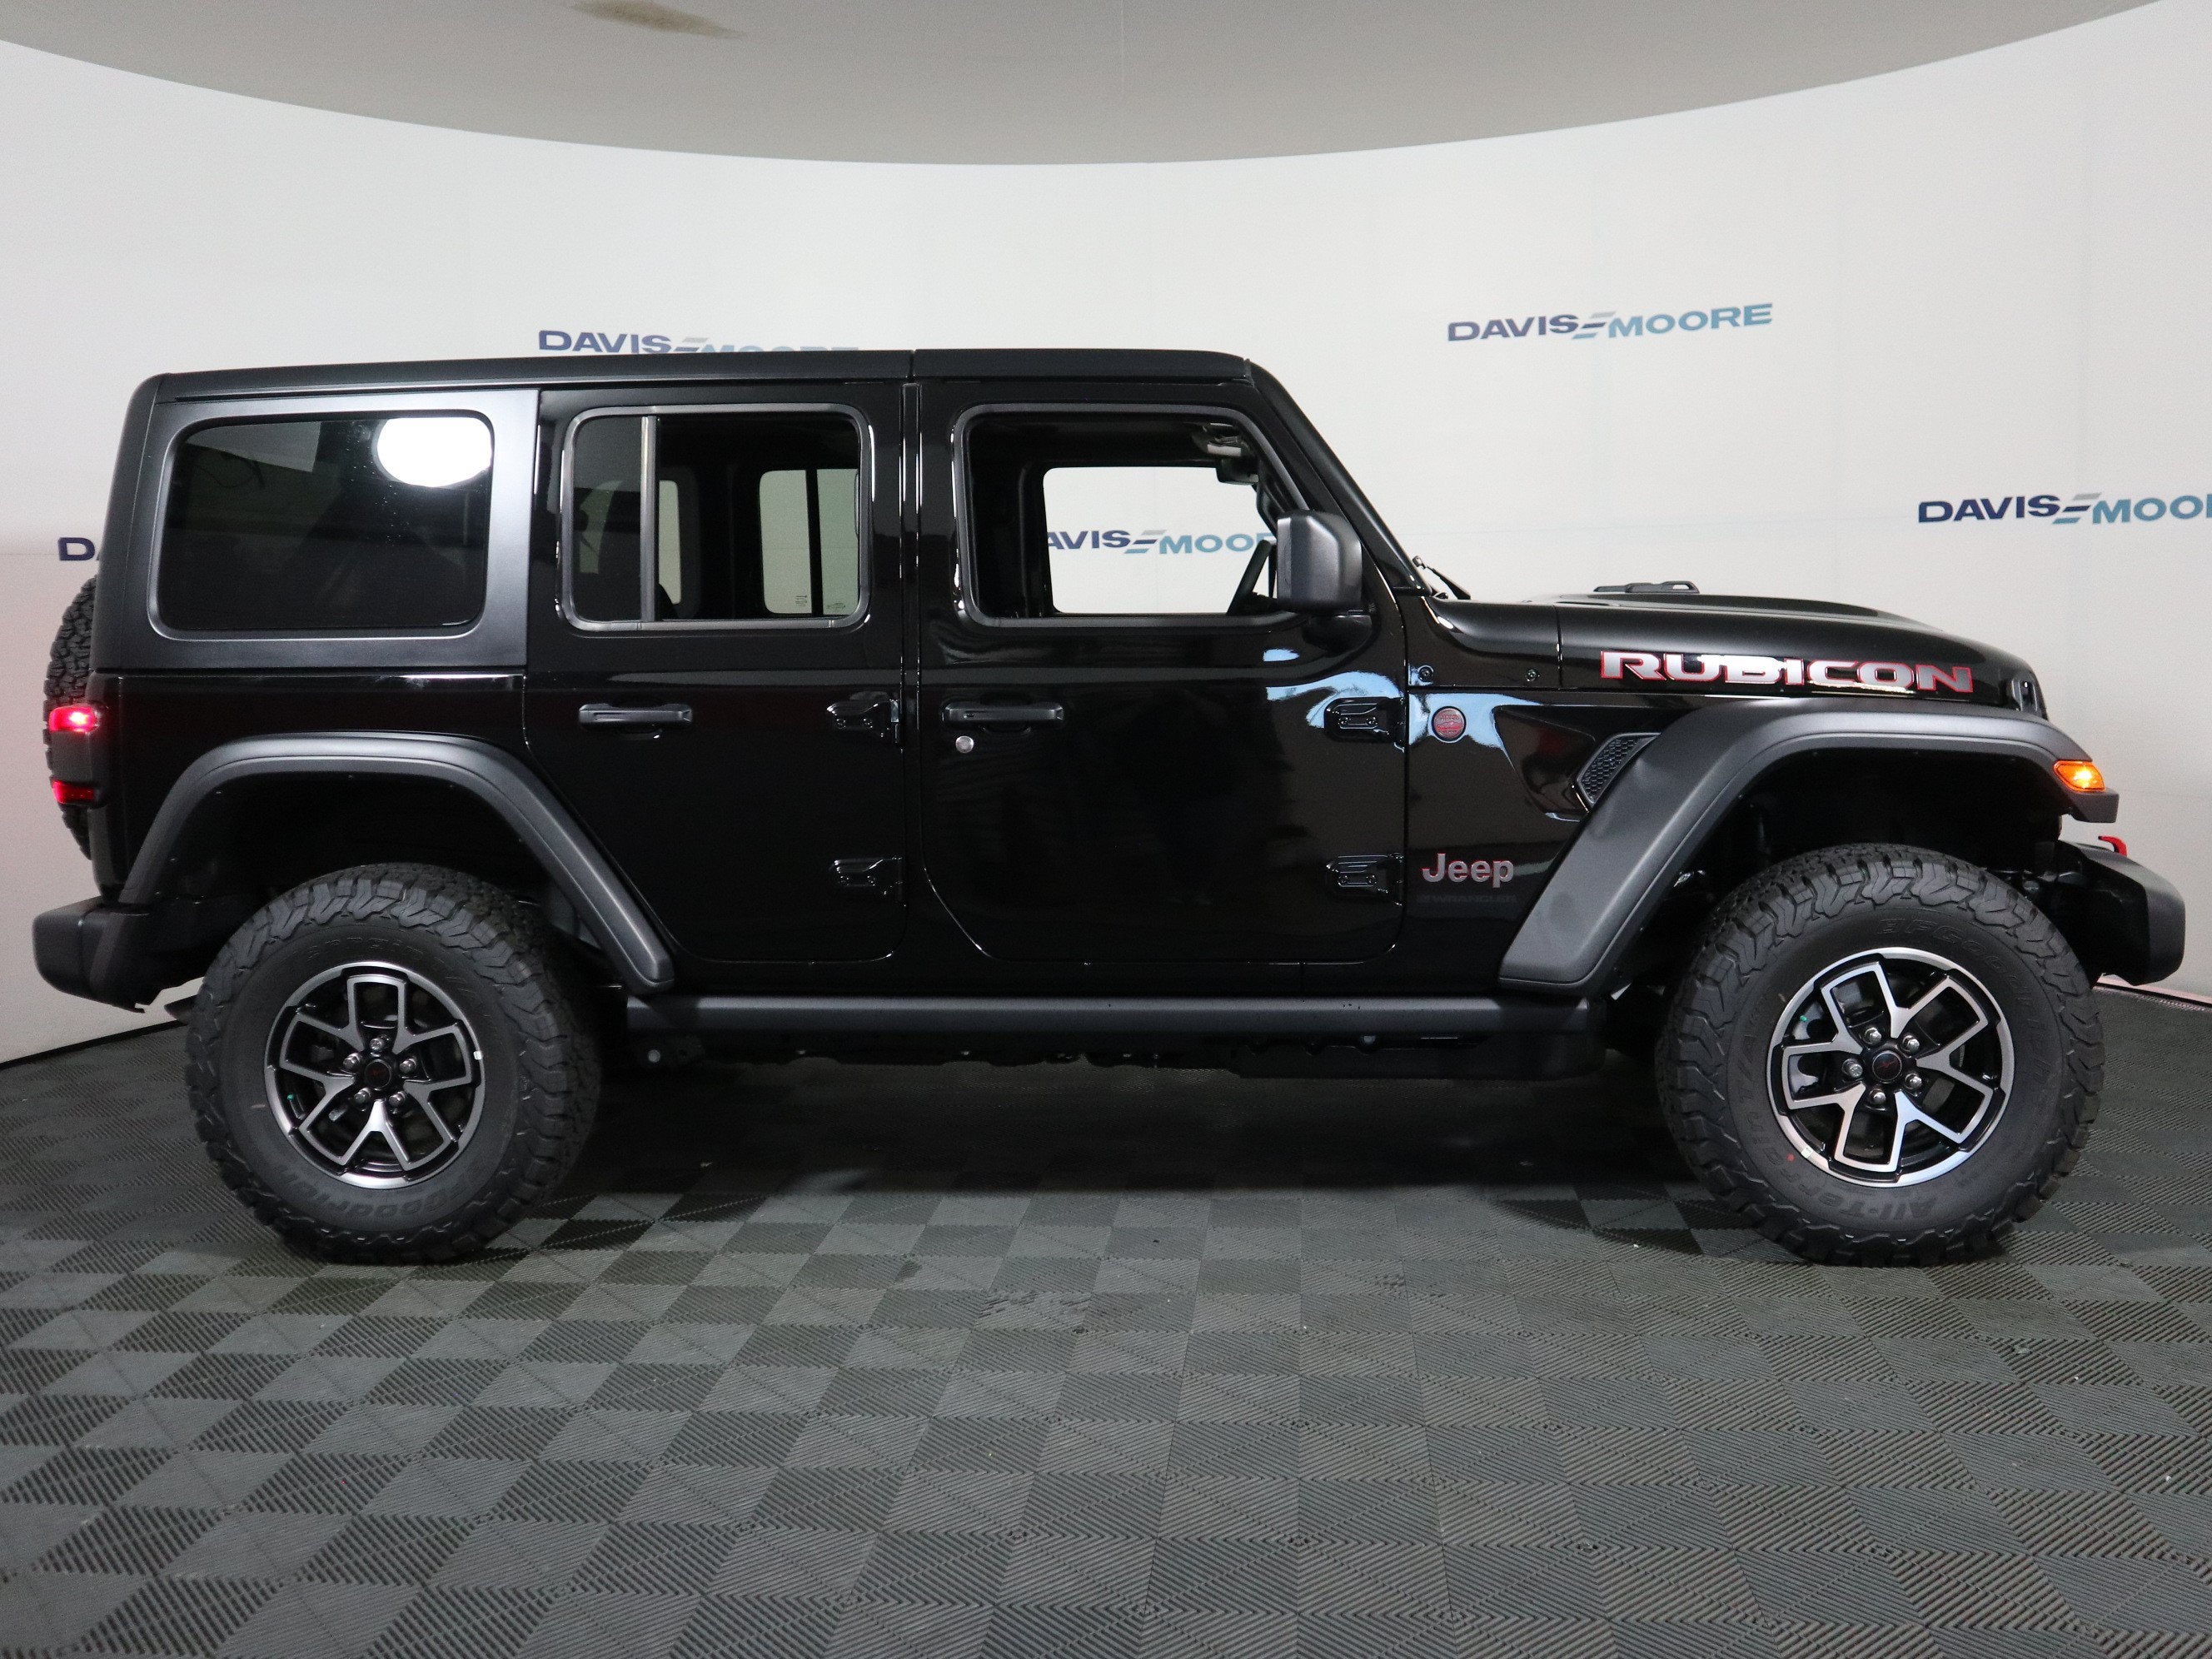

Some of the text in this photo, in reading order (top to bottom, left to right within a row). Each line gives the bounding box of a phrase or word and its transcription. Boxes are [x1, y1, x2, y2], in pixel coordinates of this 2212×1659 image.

[1447, 303, 1772, 341] DAVIS MOORE
[538, 330, 671, 354] DAVIS
[1918, 495, 2212, 524] DAVIS MOO
[1047, 530, 1276, 555] AVIS MOO
[1601, 650, 1974, 693] RUBICON
[1420, 853, 1514, 889] Jeep
